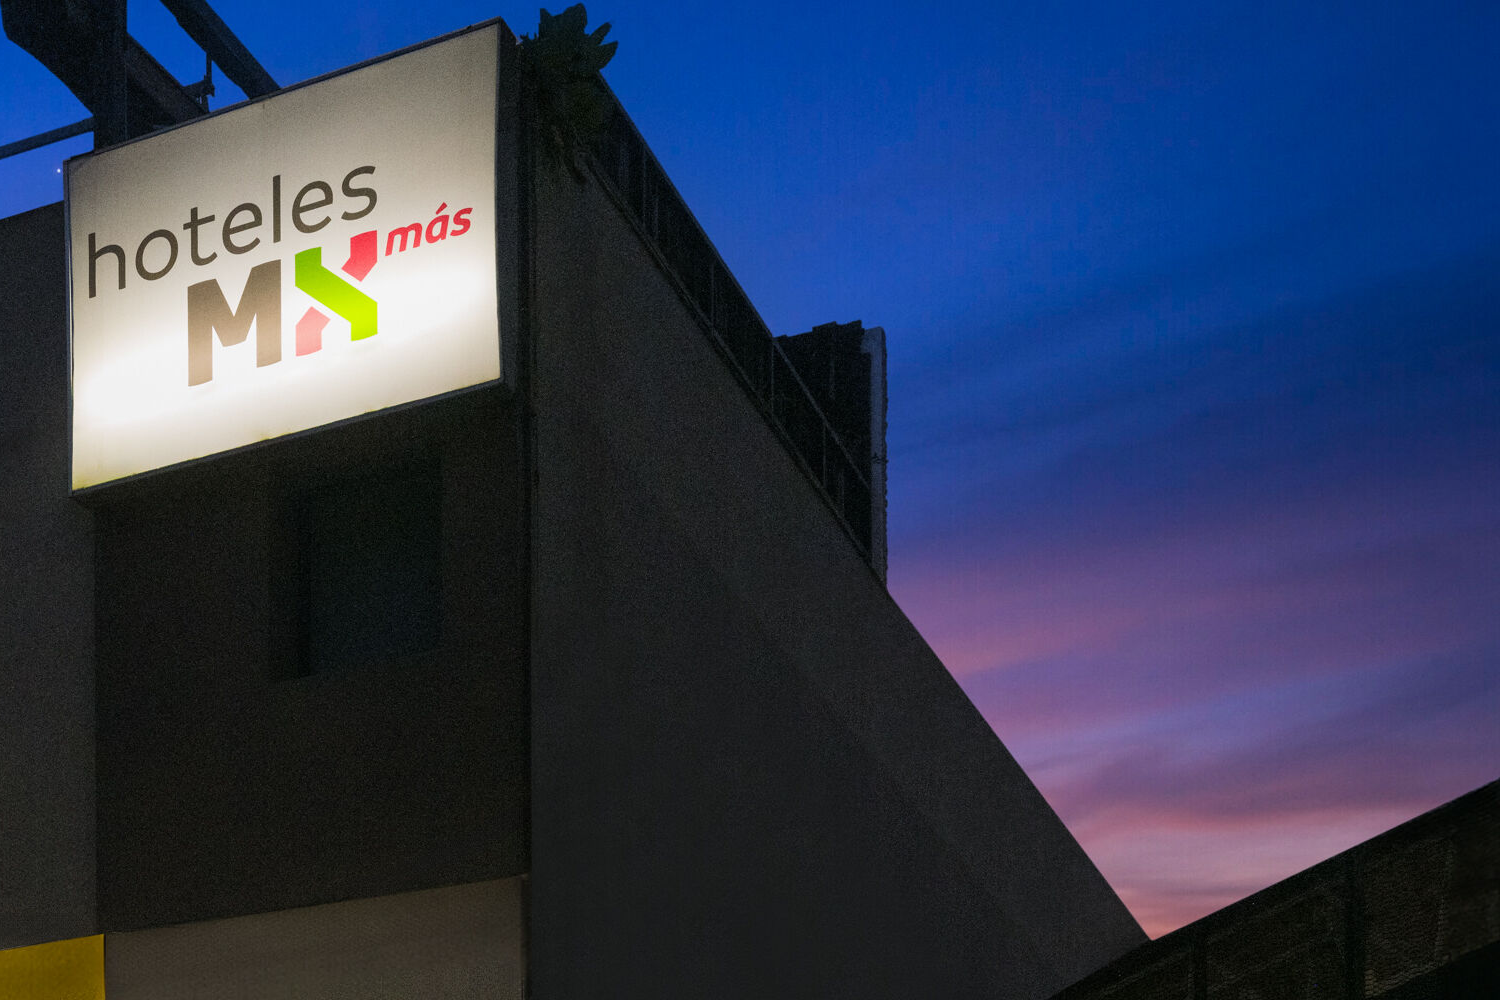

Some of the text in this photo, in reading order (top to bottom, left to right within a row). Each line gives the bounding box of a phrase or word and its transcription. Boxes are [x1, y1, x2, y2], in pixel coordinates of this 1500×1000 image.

[88, 165, 378, 299] hoteles
[187, 202, 473, 387] MX más
